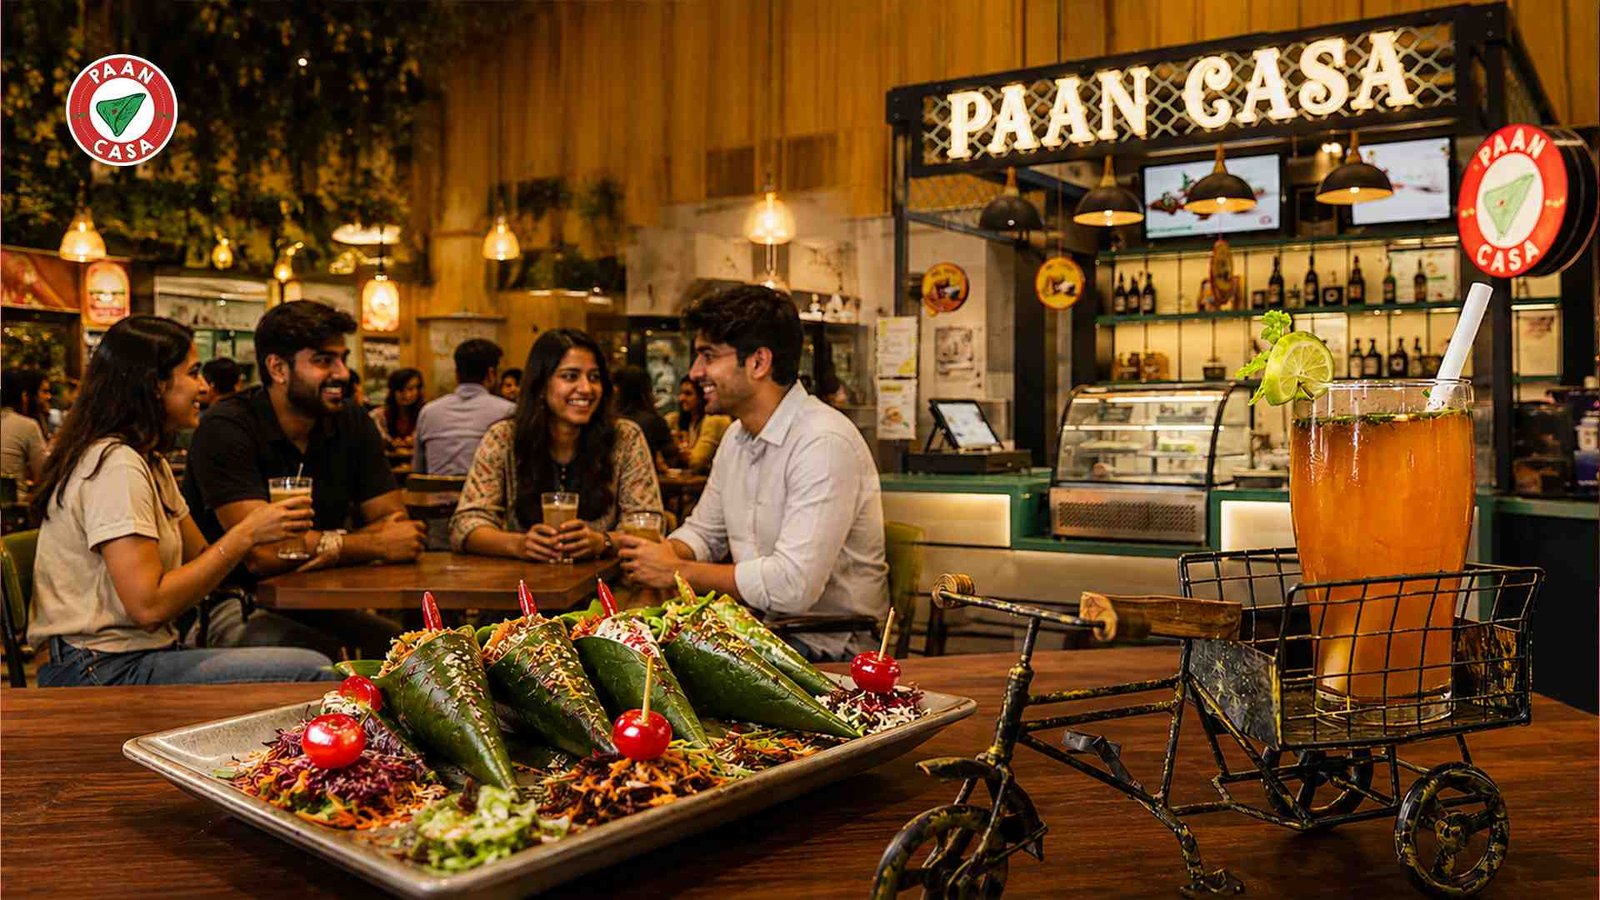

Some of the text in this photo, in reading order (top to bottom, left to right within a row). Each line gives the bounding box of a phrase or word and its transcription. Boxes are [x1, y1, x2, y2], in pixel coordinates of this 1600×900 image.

[946, 30, 1416, 159] PAAN CASA
[1478, 128, 1547, 167] PAAN
[1476, 239, 1539, 273] CASA
